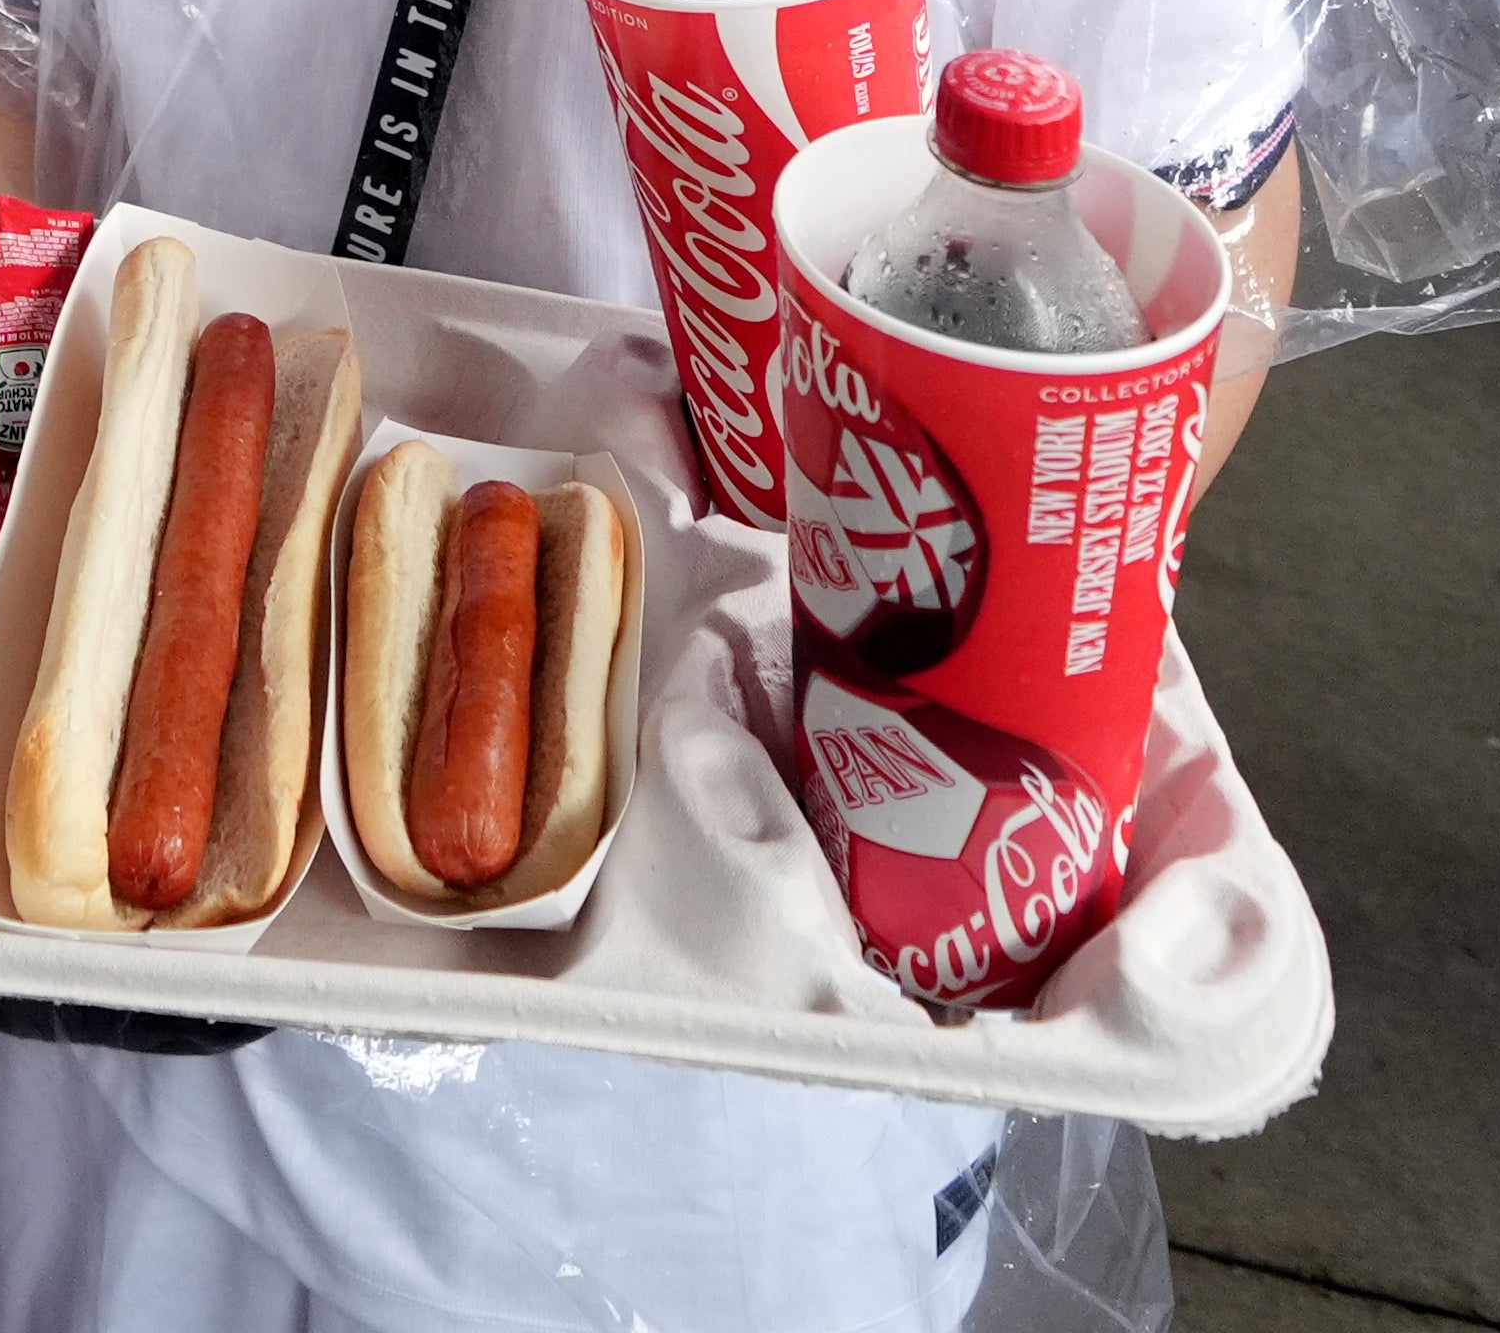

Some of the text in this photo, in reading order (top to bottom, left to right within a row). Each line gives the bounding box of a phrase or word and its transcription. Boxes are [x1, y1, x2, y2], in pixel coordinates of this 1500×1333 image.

[390, 46, 438, 99] IN
[847, 21, 876, 116] MATCH 67/104
[374, 113, 419, 161] IS
[346, 175, 403, 263] URE
[604, 48, 780, 530] Coca-Cola
[6, 332, 17, 342] BE
[18, 331, 31, 341] TO
[1039, 352, 1205, 404] COLLECTOR'S
[1135, 393, 1179, 469] 2026
[1027, 413, 1087, 545] NEW YORK
[789, 518, 859, 592] NG
[1064, 407, 1139, 676] NEW JERSEY STADIUM
[1122, 503, 1165, 566] JUNE
[811, 725, 956, 811] PAN
[852, 757, 1105, 1001] oca-Cola
